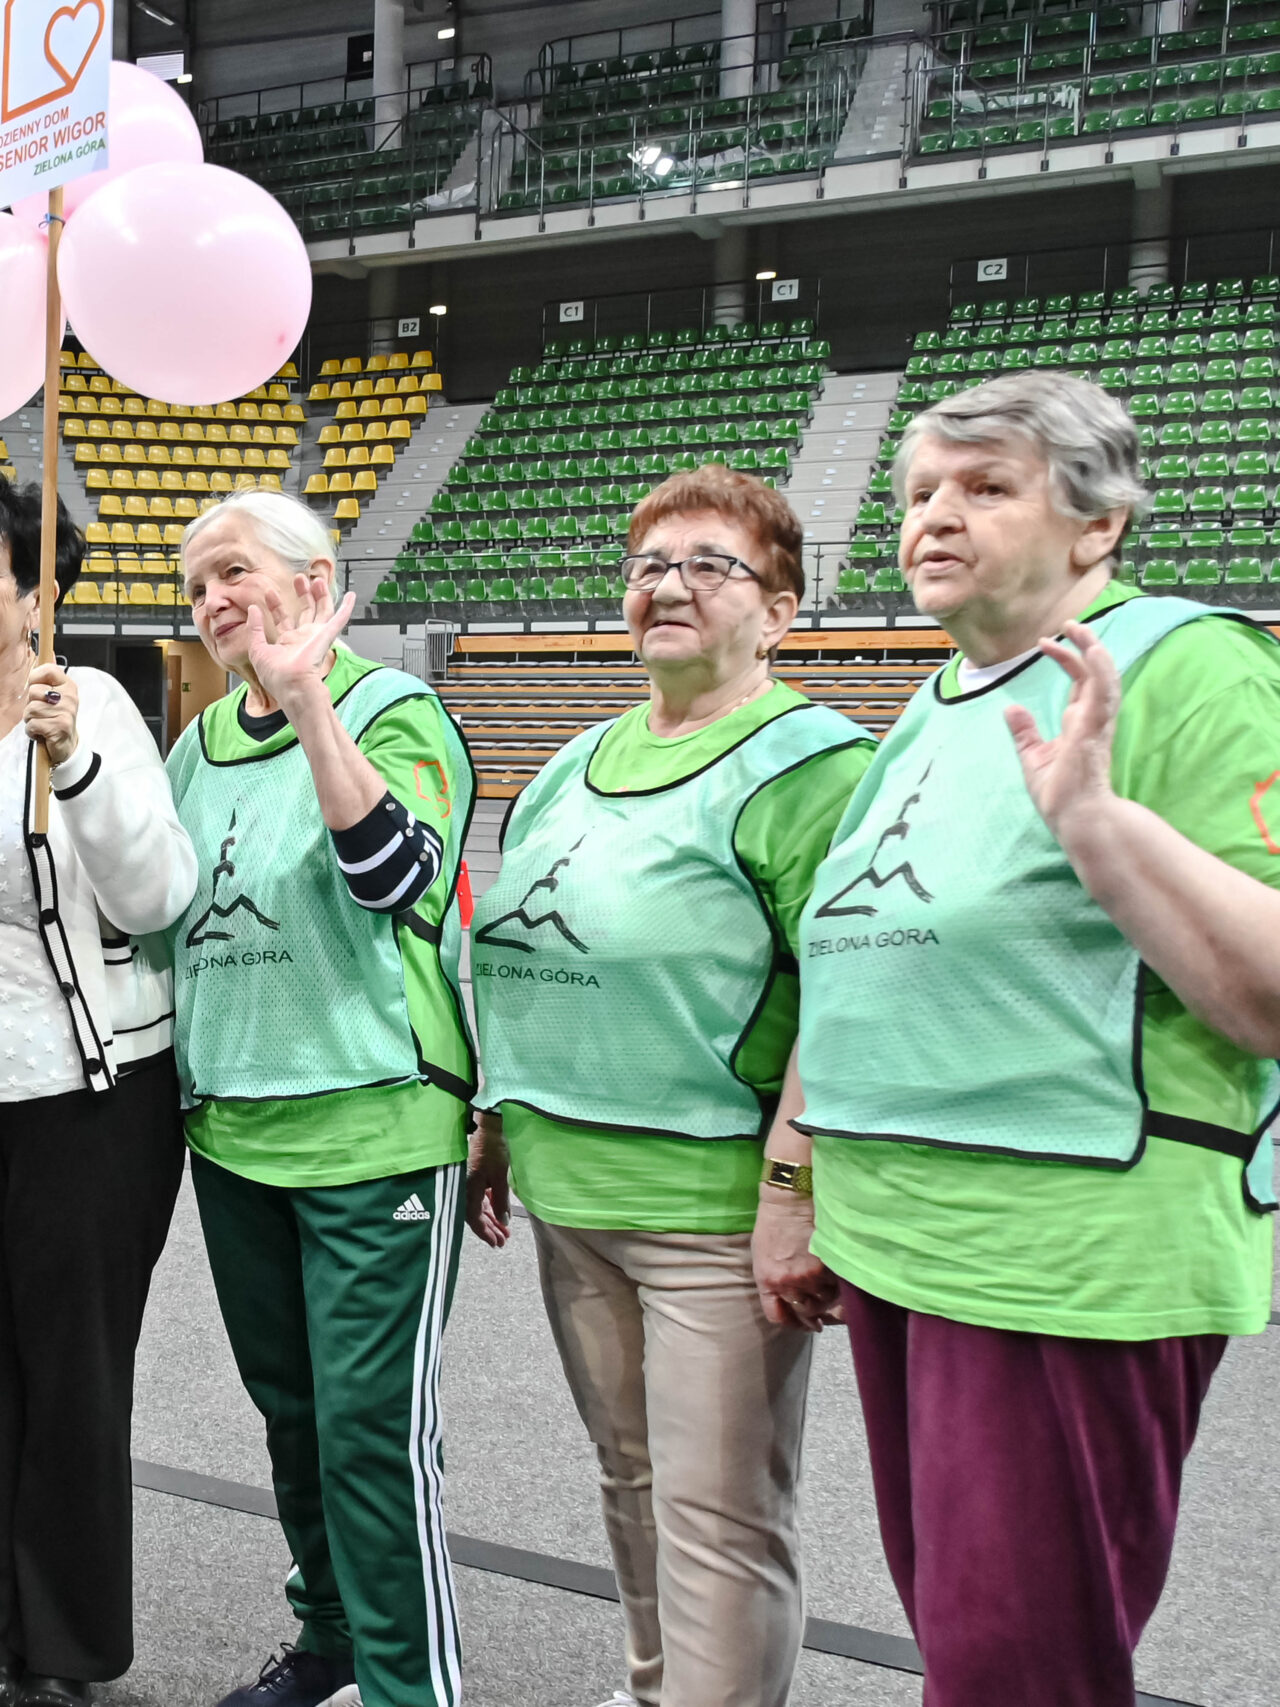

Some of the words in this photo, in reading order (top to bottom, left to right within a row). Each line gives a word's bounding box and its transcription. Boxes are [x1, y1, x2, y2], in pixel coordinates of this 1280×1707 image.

[44, 106, 69, 129] DOM
[53, 111, 106, 148] WIGOR
[34, 151, 73, 176] ZIELONA
[76, 137, 106, 158] GÓRA
[983, 264, 1003, 276] C2
[777, 284, 794, 296] C1
[564, 308, 579, 318] C1
[402, 322, 418, 333] B2
[540, 968, 600, 989] GÓRA
[392, 1210, 431, 1221] adidas
